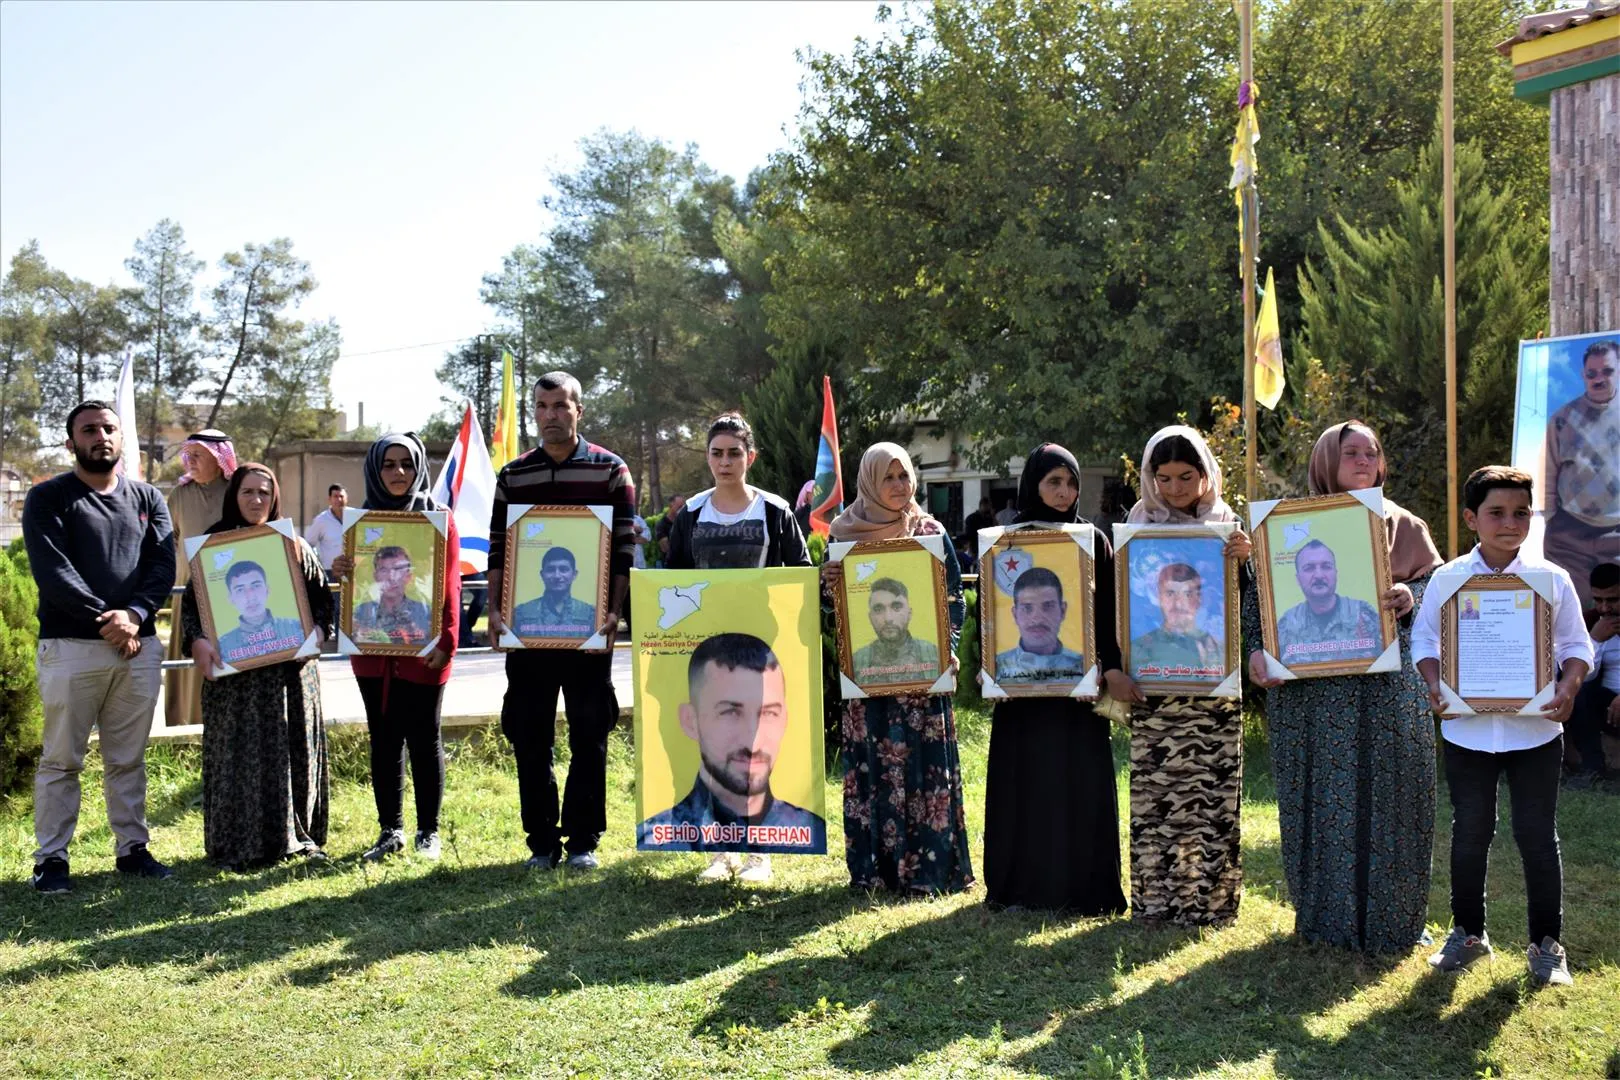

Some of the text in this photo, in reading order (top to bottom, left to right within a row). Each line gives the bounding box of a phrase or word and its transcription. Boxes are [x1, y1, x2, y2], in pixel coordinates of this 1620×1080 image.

[1193, 663, 1225, 677] الشهيد
[654, 821, 698, 844] ŞEHÎD
[748, 825, 811, 844] FERHAN
